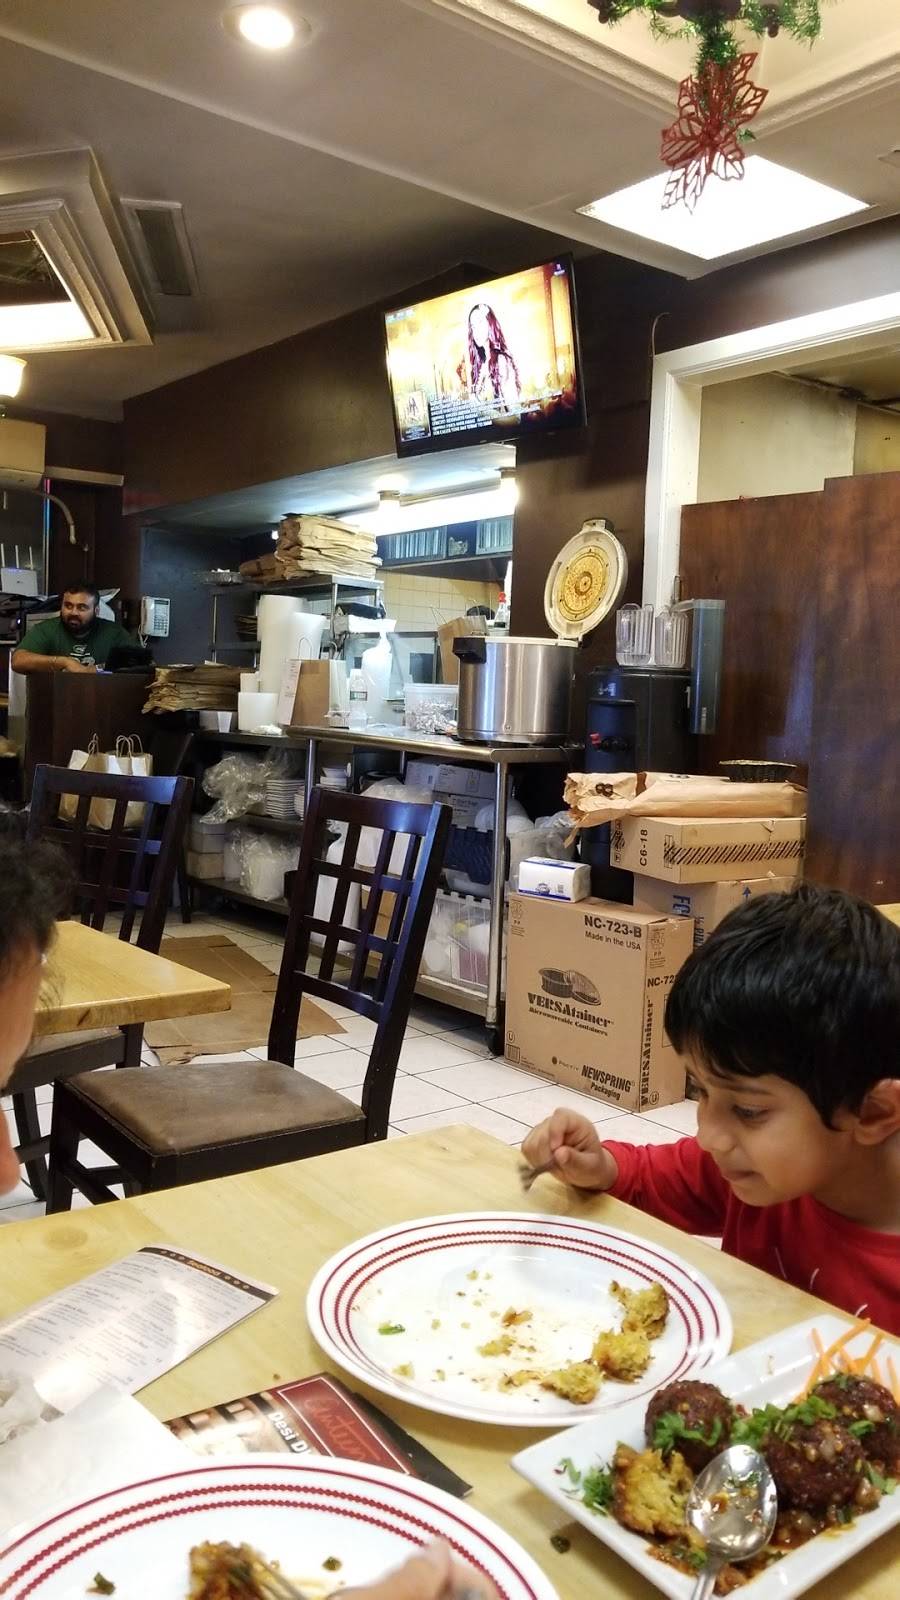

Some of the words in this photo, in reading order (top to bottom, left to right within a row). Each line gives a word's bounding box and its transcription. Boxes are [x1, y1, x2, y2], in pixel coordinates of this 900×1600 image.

[584, 914, 642, 938] NC-723-B
[585, 931, 604, 942] Made
[605, 936, 612, 944] in
[613, 937, 624, 946] the
[626, 941, 641, 951] USA
[527, 992, 611, 1028] VERSAtainer
[581, 1064, 632, 1093] NEWSPRING
[591, 1082, 620, 1101] Packaging
[268, 1411, 299, 1441] Desi
